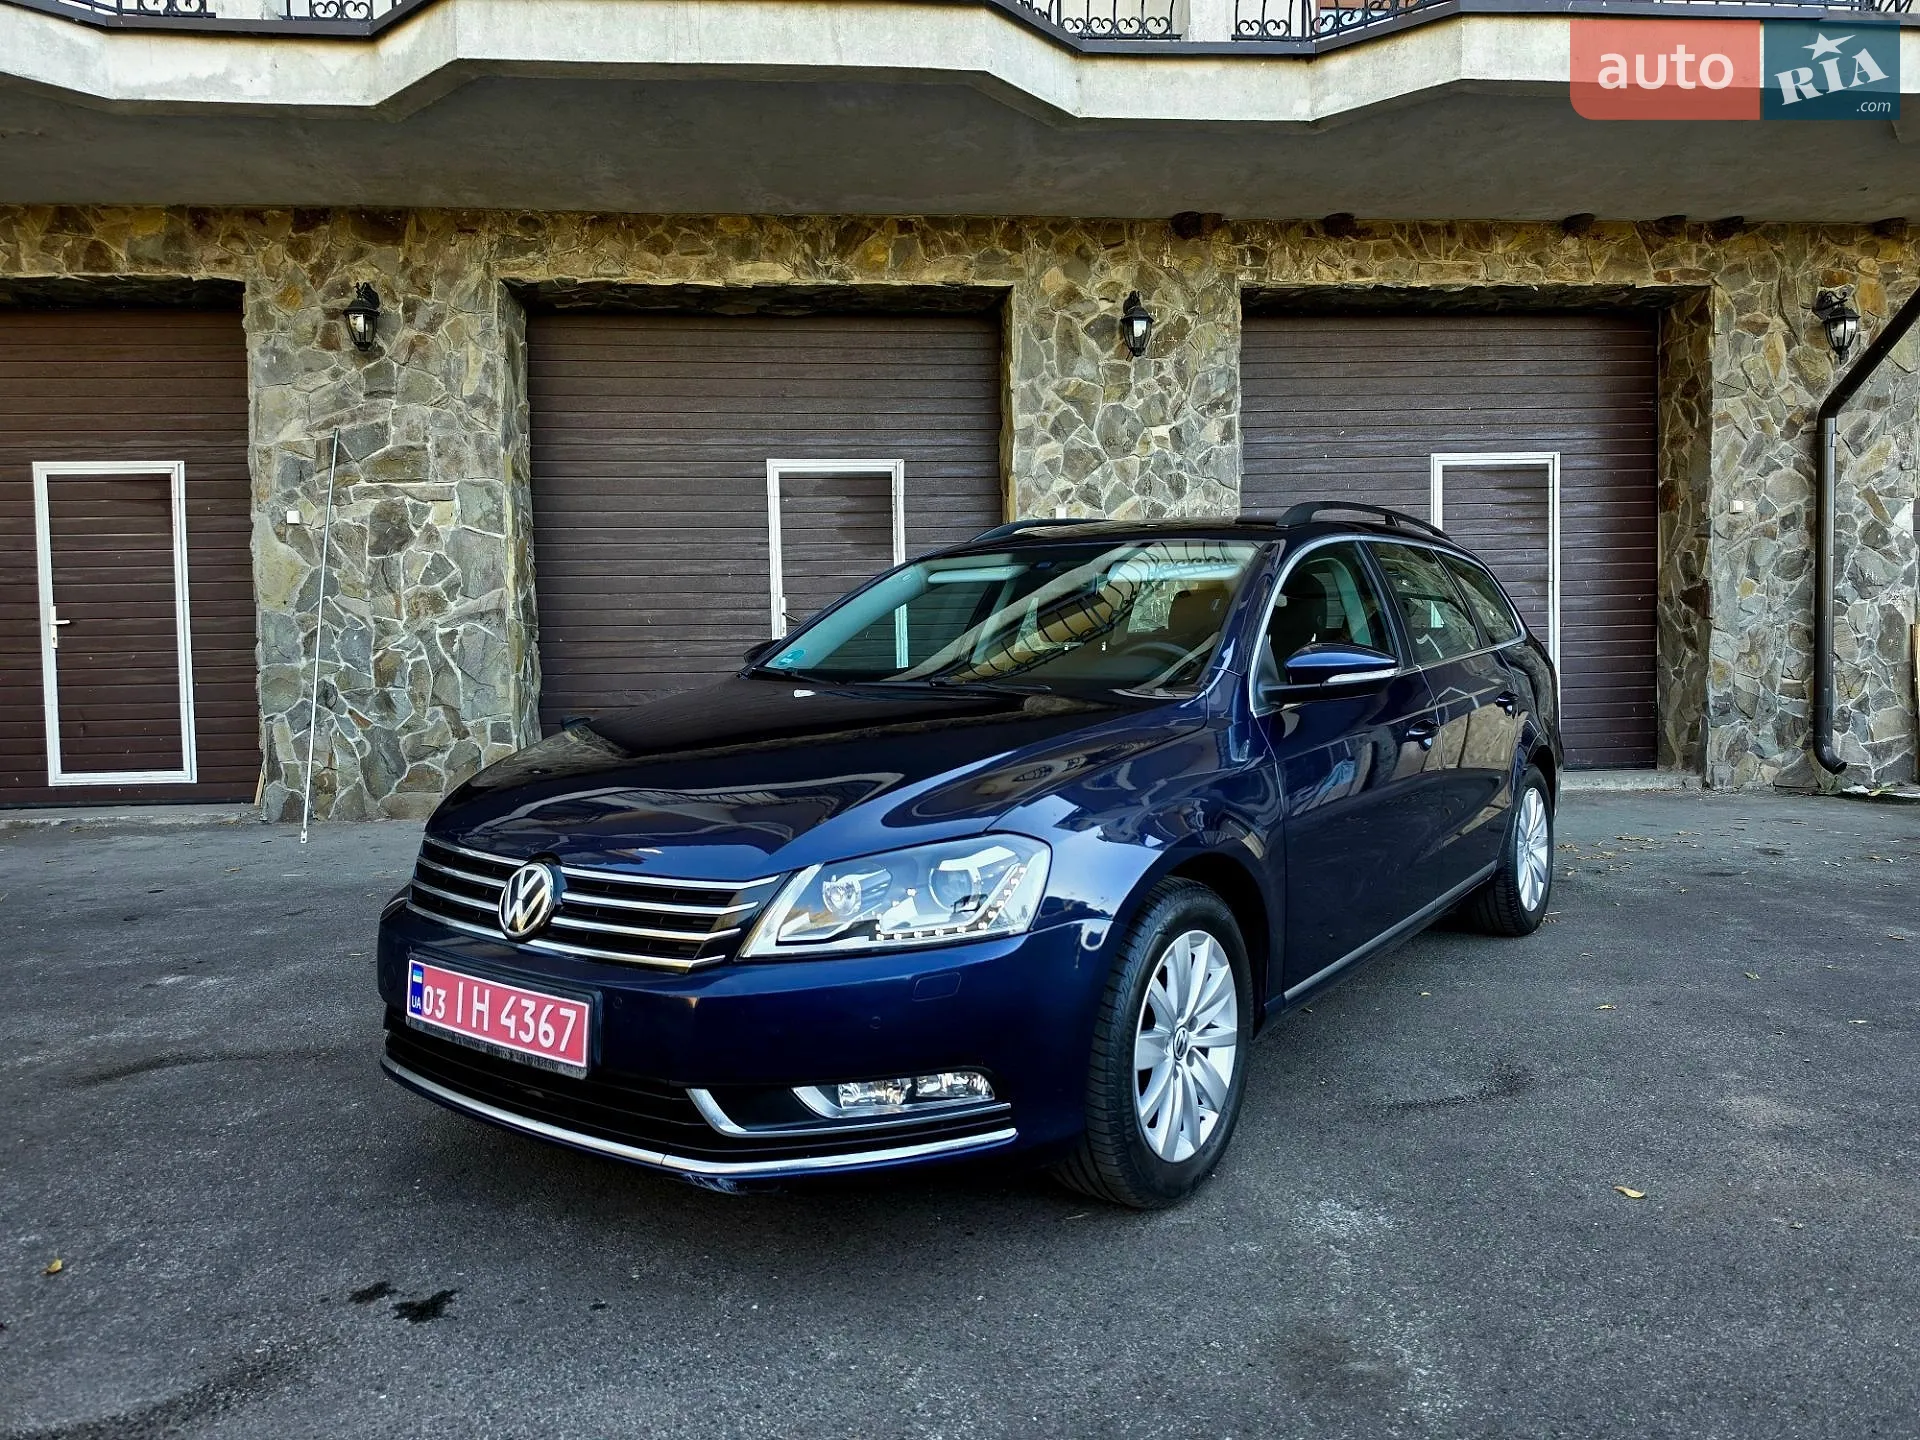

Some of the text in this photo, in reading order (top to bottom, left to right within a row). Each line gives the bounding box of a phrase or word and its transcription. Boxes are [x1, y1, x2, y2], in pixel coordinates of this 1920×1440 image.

[411, 995, 421, 1009] UA
[423, 985, 447, 1019] 03
[500, 995, 577, 1052] 4367
